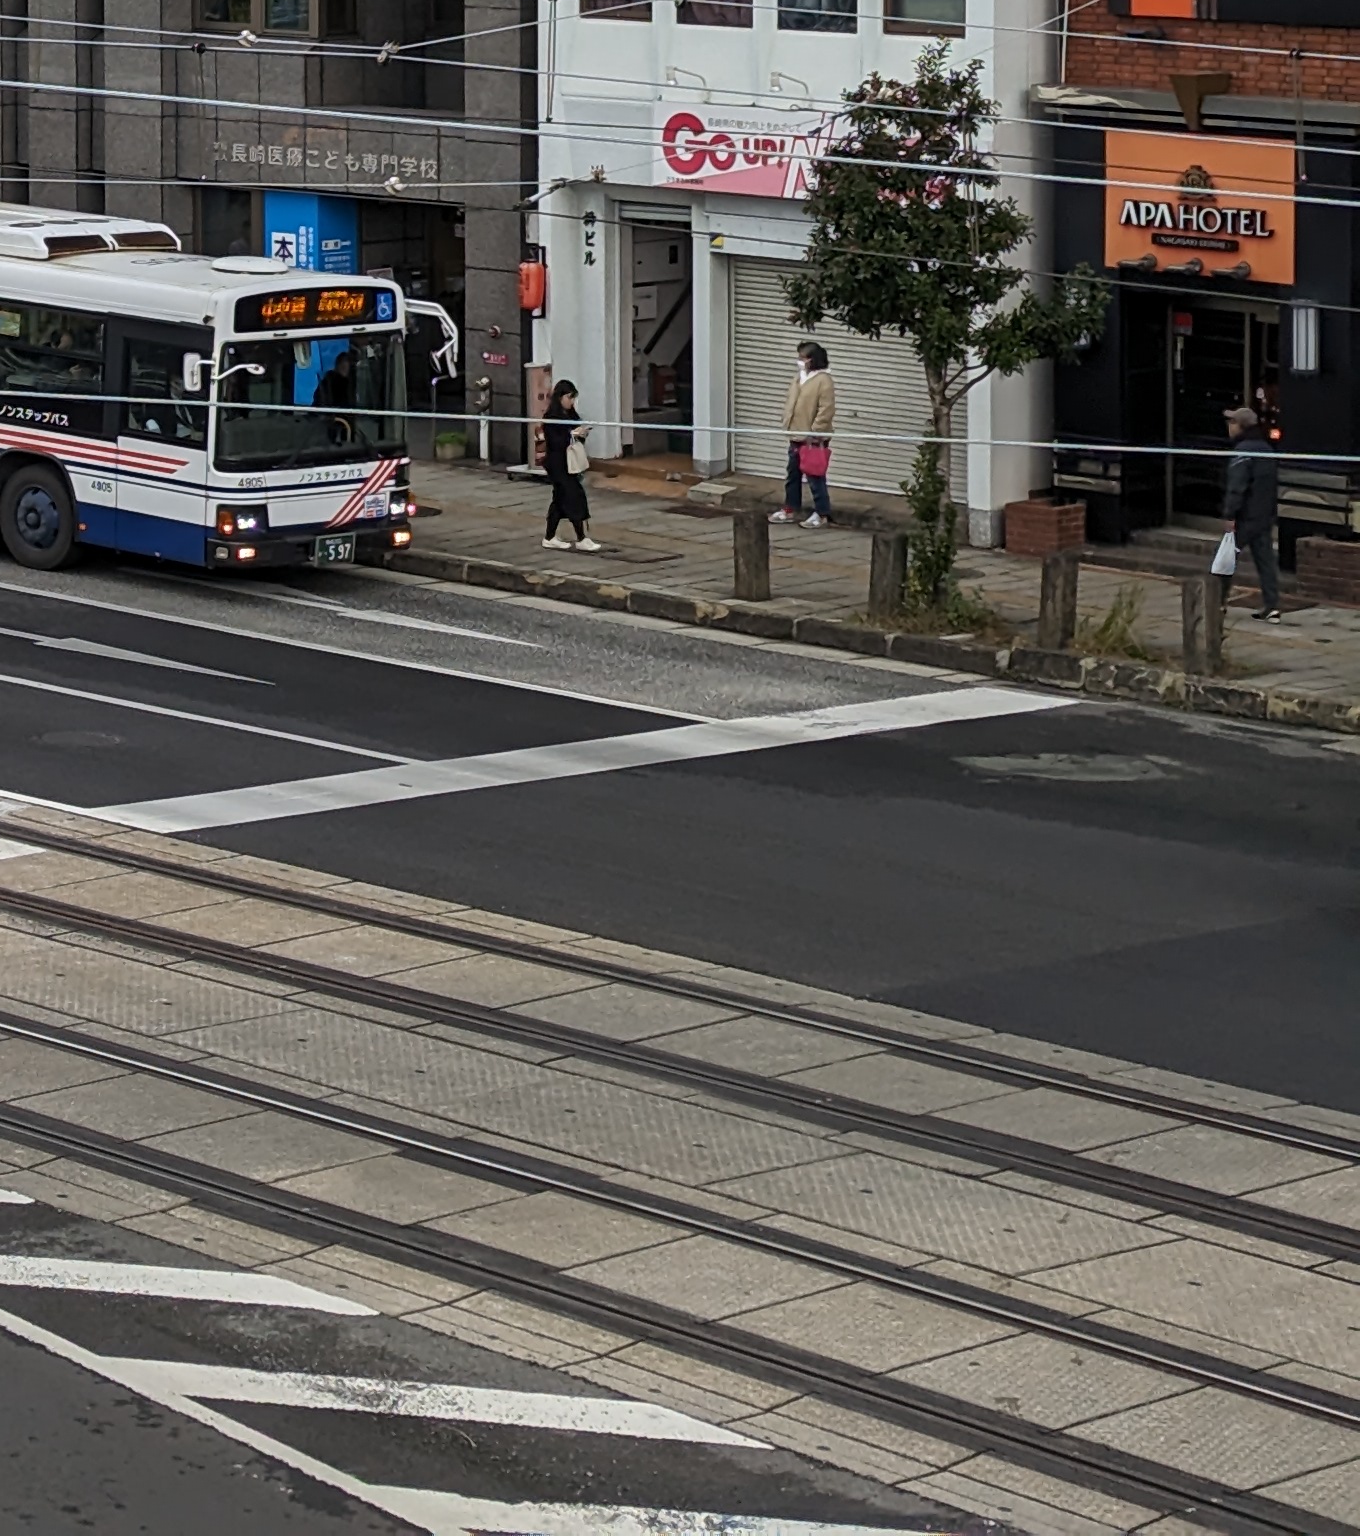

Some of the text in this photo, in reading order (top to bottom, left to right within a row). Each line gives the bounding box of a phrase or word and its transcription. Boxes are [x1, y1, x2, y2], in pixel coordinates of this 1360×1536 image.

[231, 143, 439, 180] 長崎医療こども専門学校
[742, 137, 786, 169] UP!
[1120, 199, 1271, 238] APA HOTEL
[273, 236, 294, 262] 本
[90, 480, 113, 493] 4905
[299, 467, 364, 483] ノンステップバス
